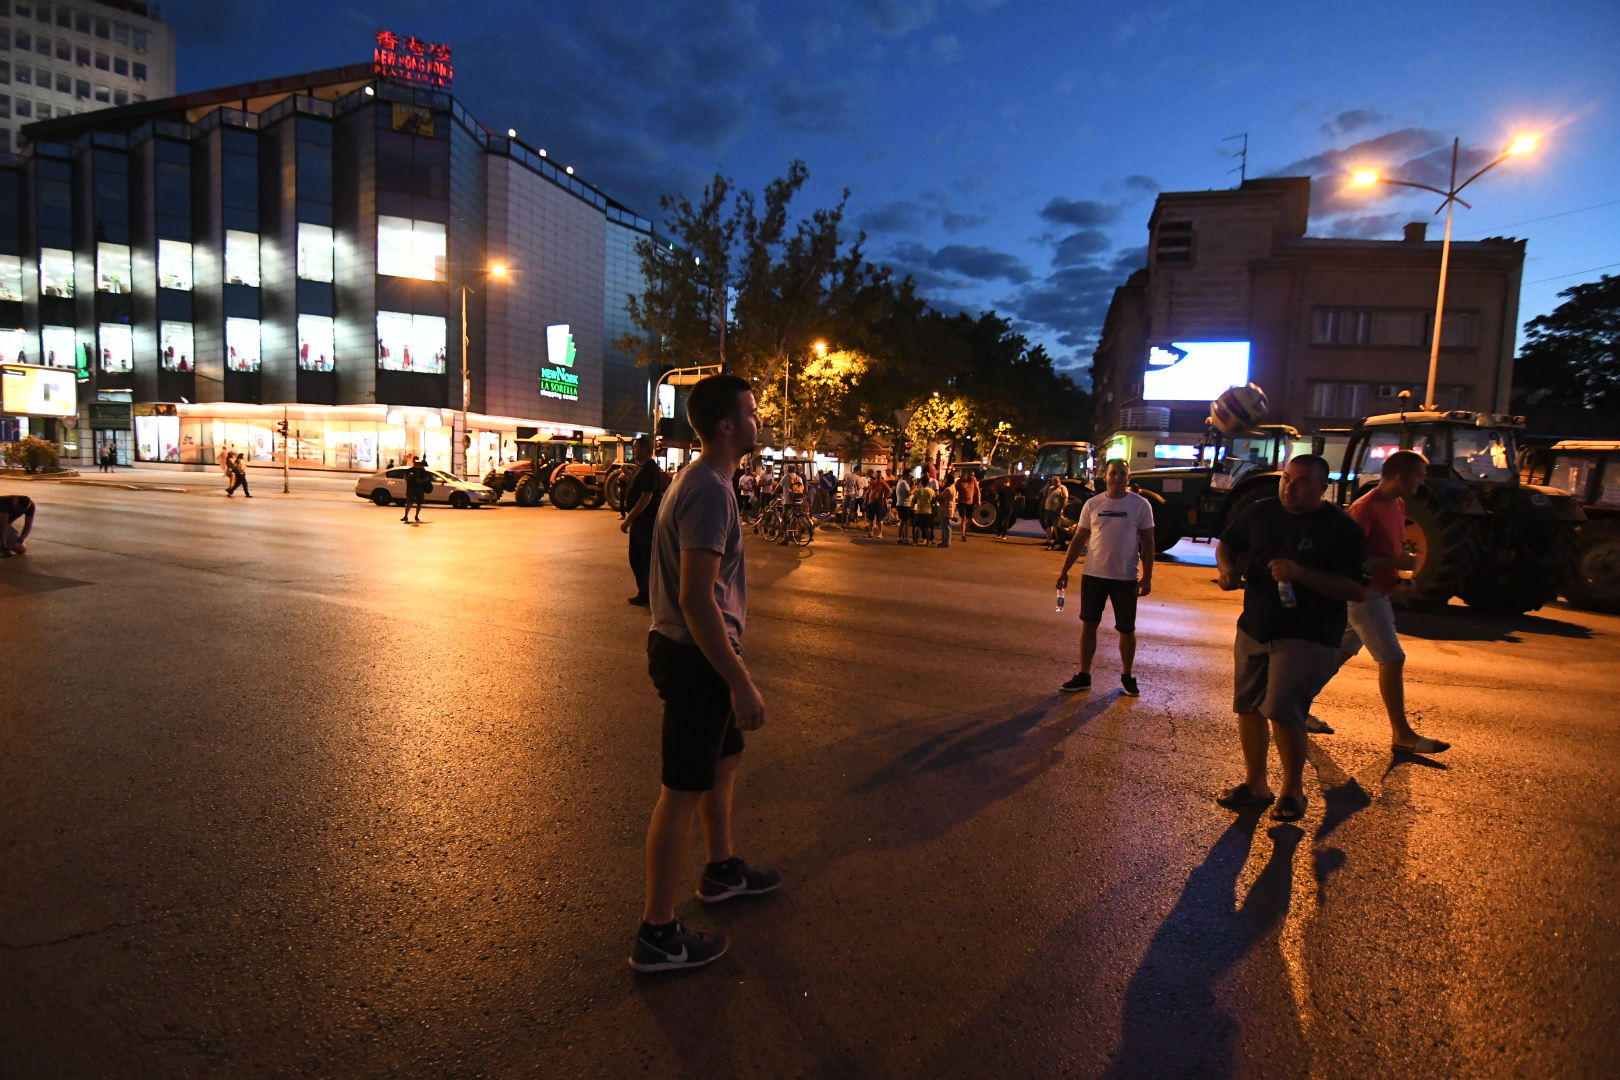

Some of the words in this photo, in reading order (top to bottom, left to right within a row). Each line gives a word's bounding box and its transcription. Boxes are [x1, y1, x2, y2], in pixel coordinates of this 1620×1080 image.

[374, 48, 396, 65] NEW
[398, 55, 425, 72] HONG
[427, 61, 453, 78] KONG
[374, 65, 451, 87] RESTAURAN
[541, 381, 549, 389] LA
[550, 383, 578, 395] SORELLA
